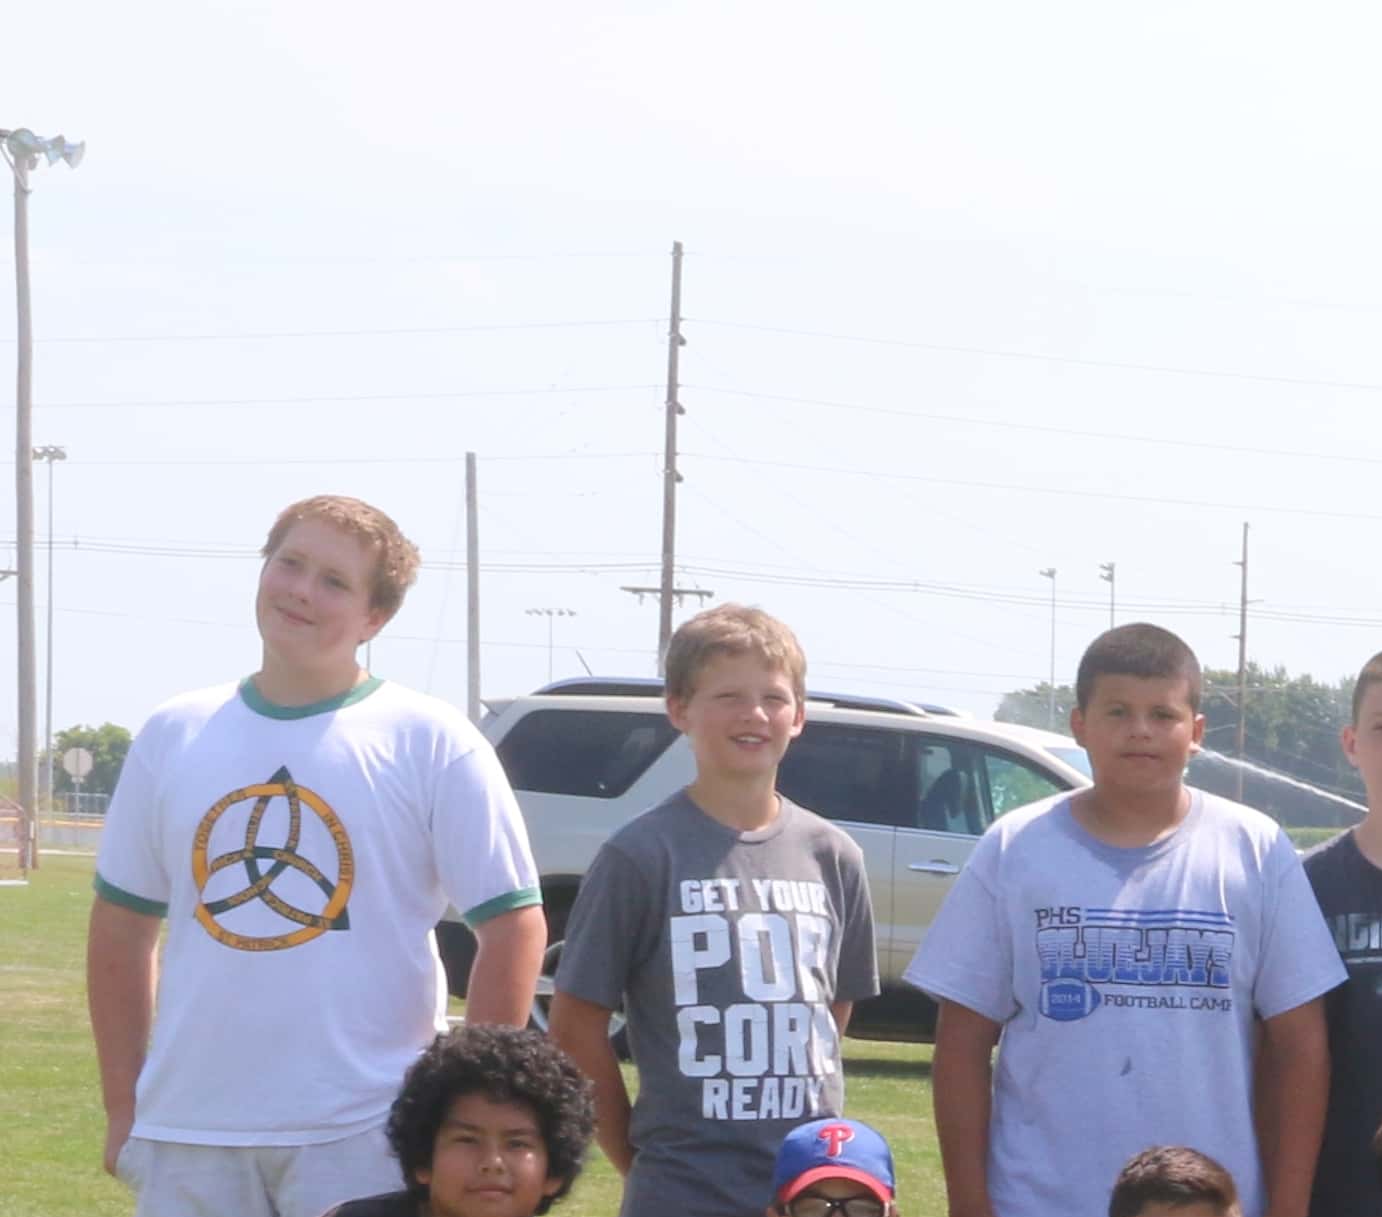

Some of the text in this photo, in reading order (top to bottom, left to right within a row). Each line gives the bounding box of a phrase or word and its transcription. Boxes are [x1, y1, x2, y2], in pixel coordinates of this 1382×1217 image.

[680, 879, 829, 914] GET YOUR
[1035, 906, 1082, 927] PHS
[670, 913, 833, 1005] POP
[1103, 994, 1188, 1010] FOOTBALL
[677, 1002, 840, 1078] CORN
[702, 1078, 826, 1121] READY
[819, 1123, 856, 1158] P
